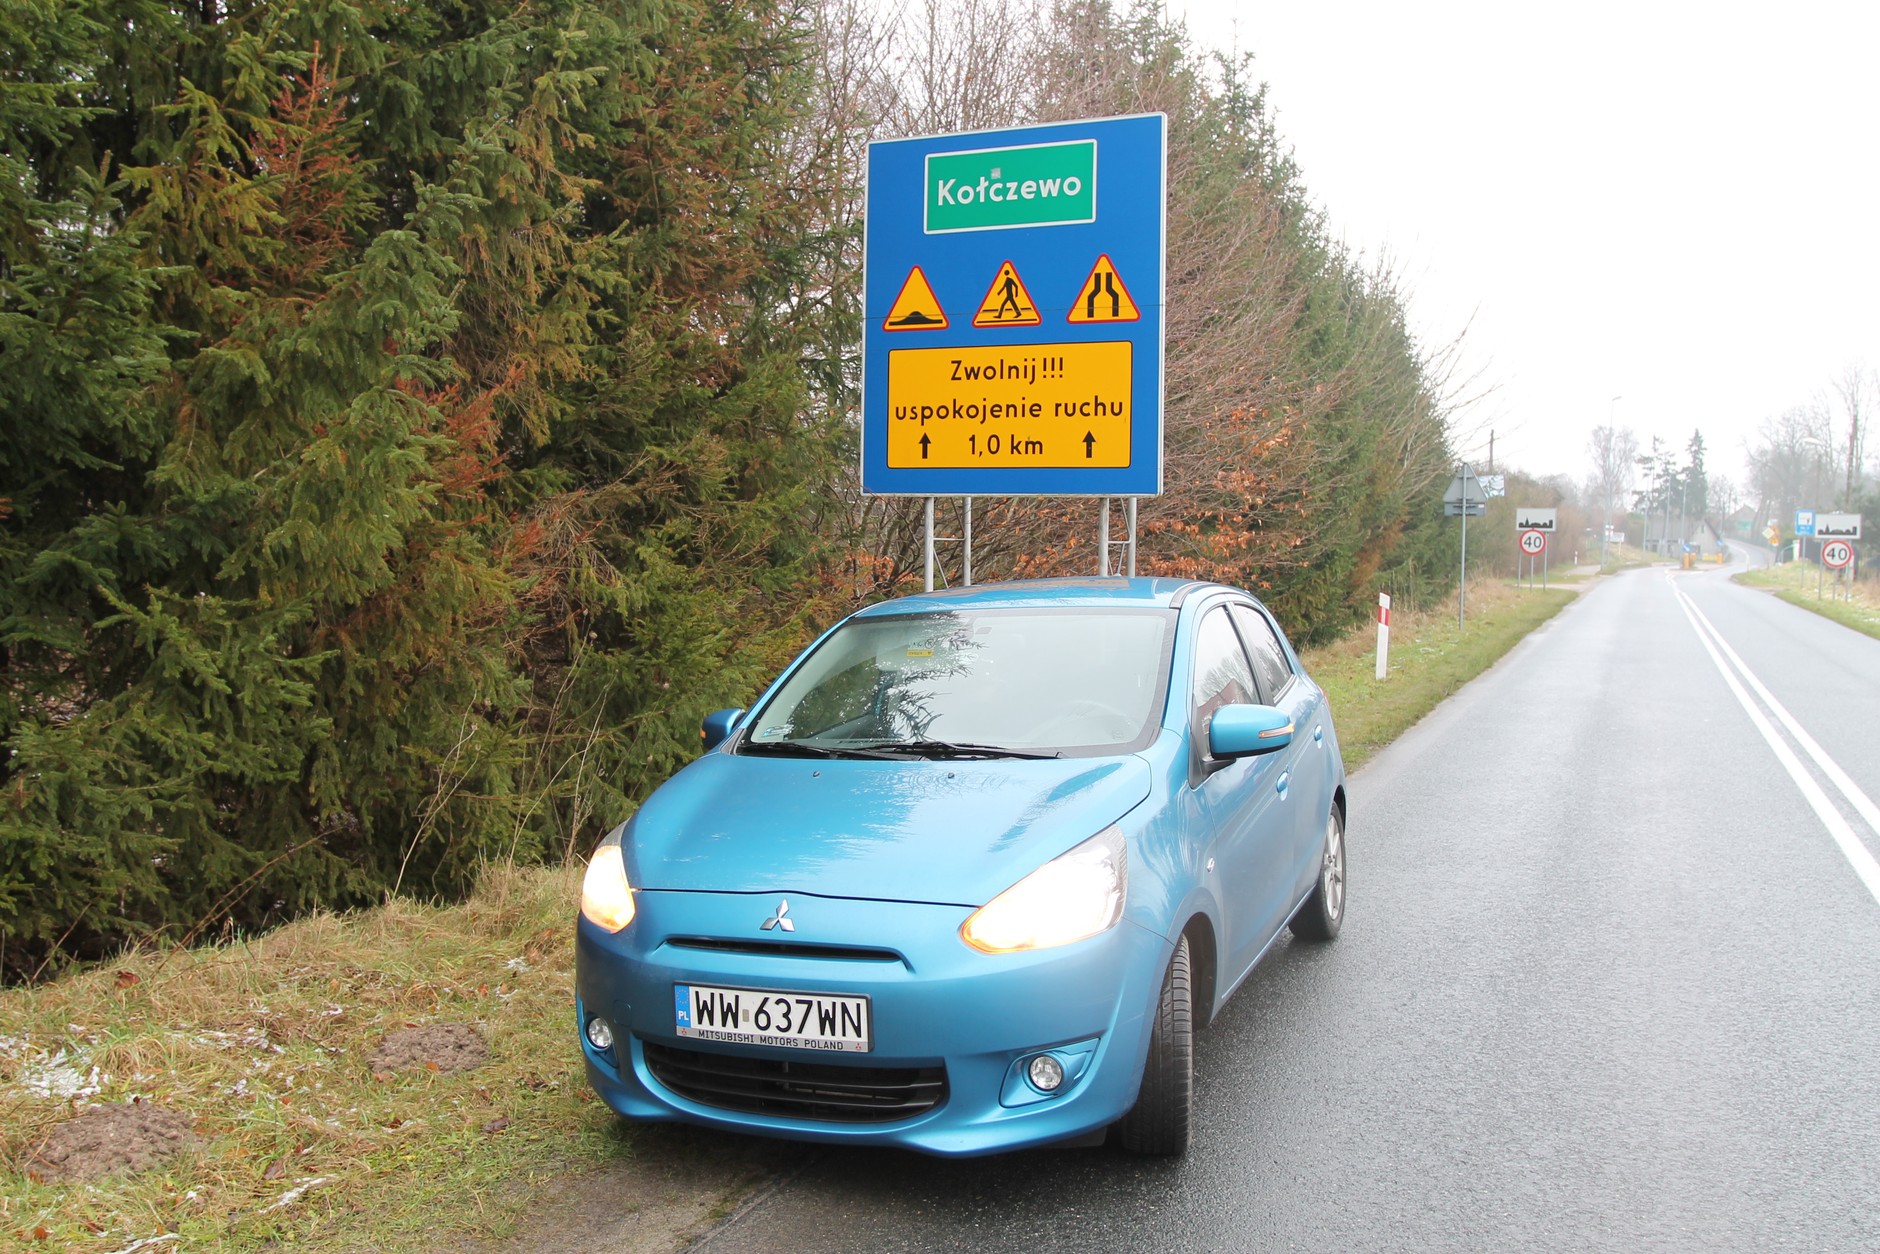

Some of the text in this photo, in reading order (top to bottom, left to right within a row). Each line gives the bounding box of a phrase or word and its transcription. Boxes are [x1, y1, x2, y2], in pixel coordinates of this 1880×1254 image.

[937, 176, 1082, 206] Kołczewo
[950, 357, 1064, 385] Zwolnij!!!
[895, 395, 1124, 426] uspokojenie ruchu
[968, 434, 1044, 458] 1,0 km
[1523, 536, 1542, 549] 40
[1826, 547, 1848, 560] 40
[678, 1010, 689, 1021] PL
[695, 990, 862, 1038] WW 637WN
[698, 1029, 844, 1051] MITSUBISHI MOTORS POLAND
